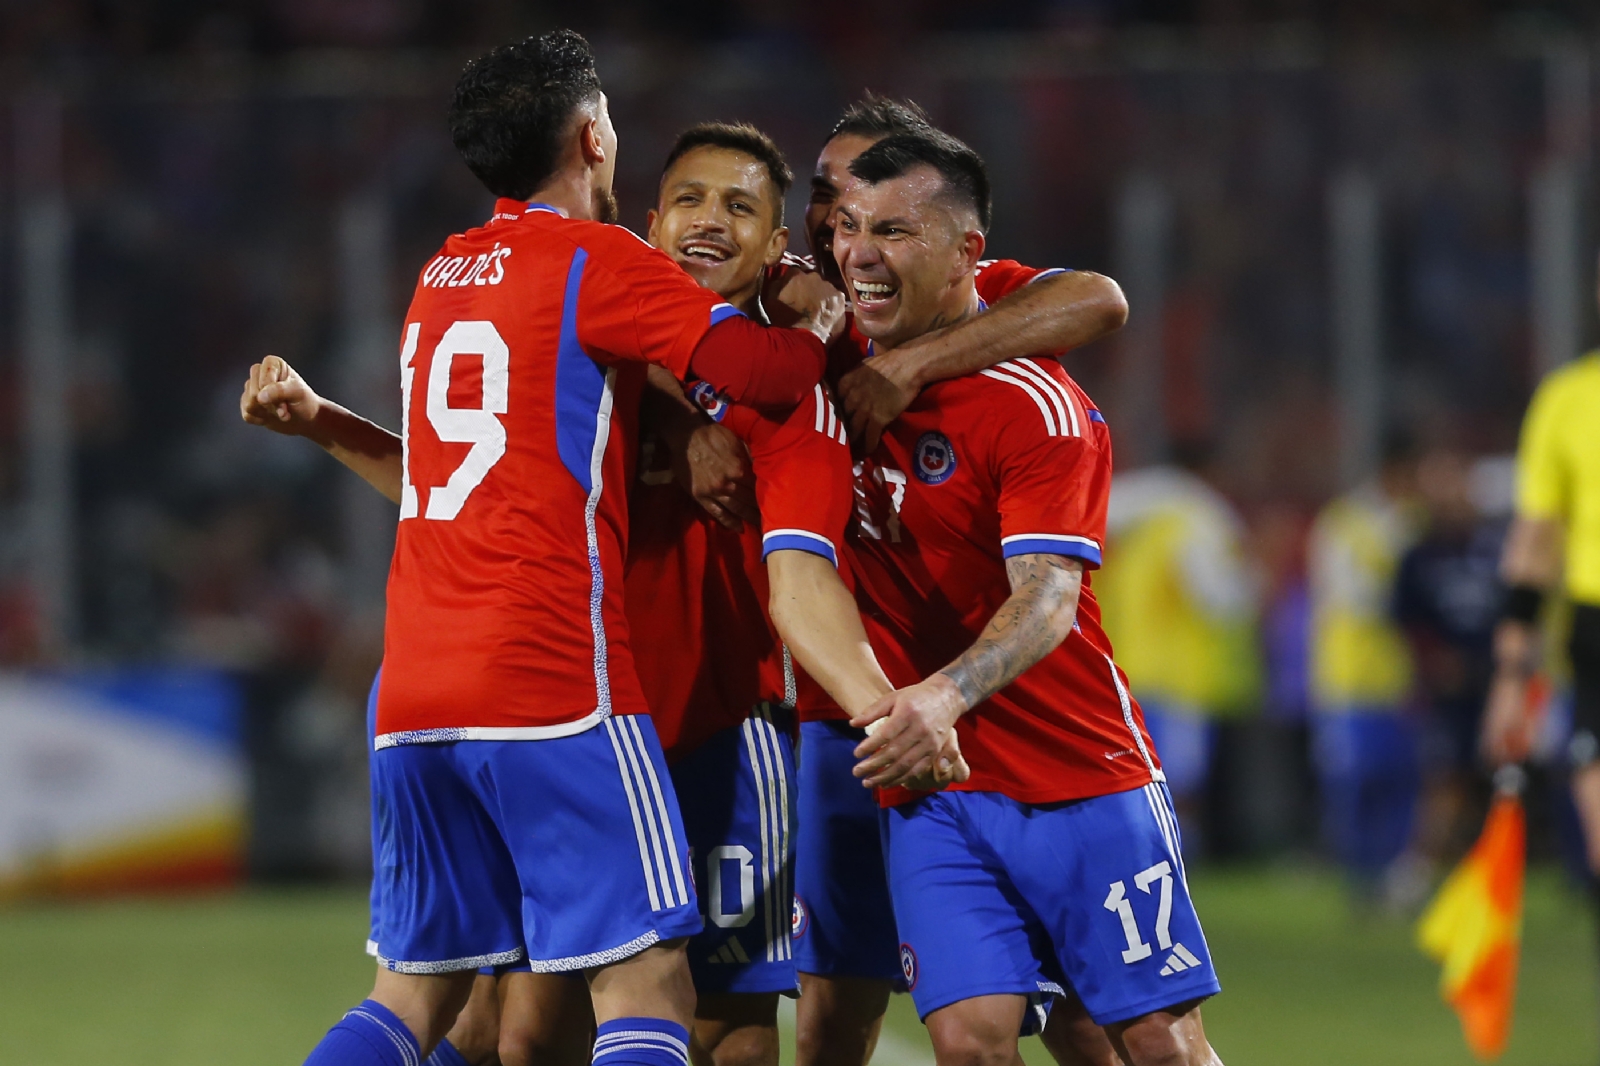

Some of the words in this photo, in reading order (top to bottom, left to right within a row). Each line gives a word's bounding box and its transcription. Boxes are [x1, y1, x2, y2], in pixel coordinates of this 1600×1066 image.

[423, 242, 512, 288] VALDÉS
[400, 321, 509, 521] 19
[1103, 860, 1173, 964] 17
